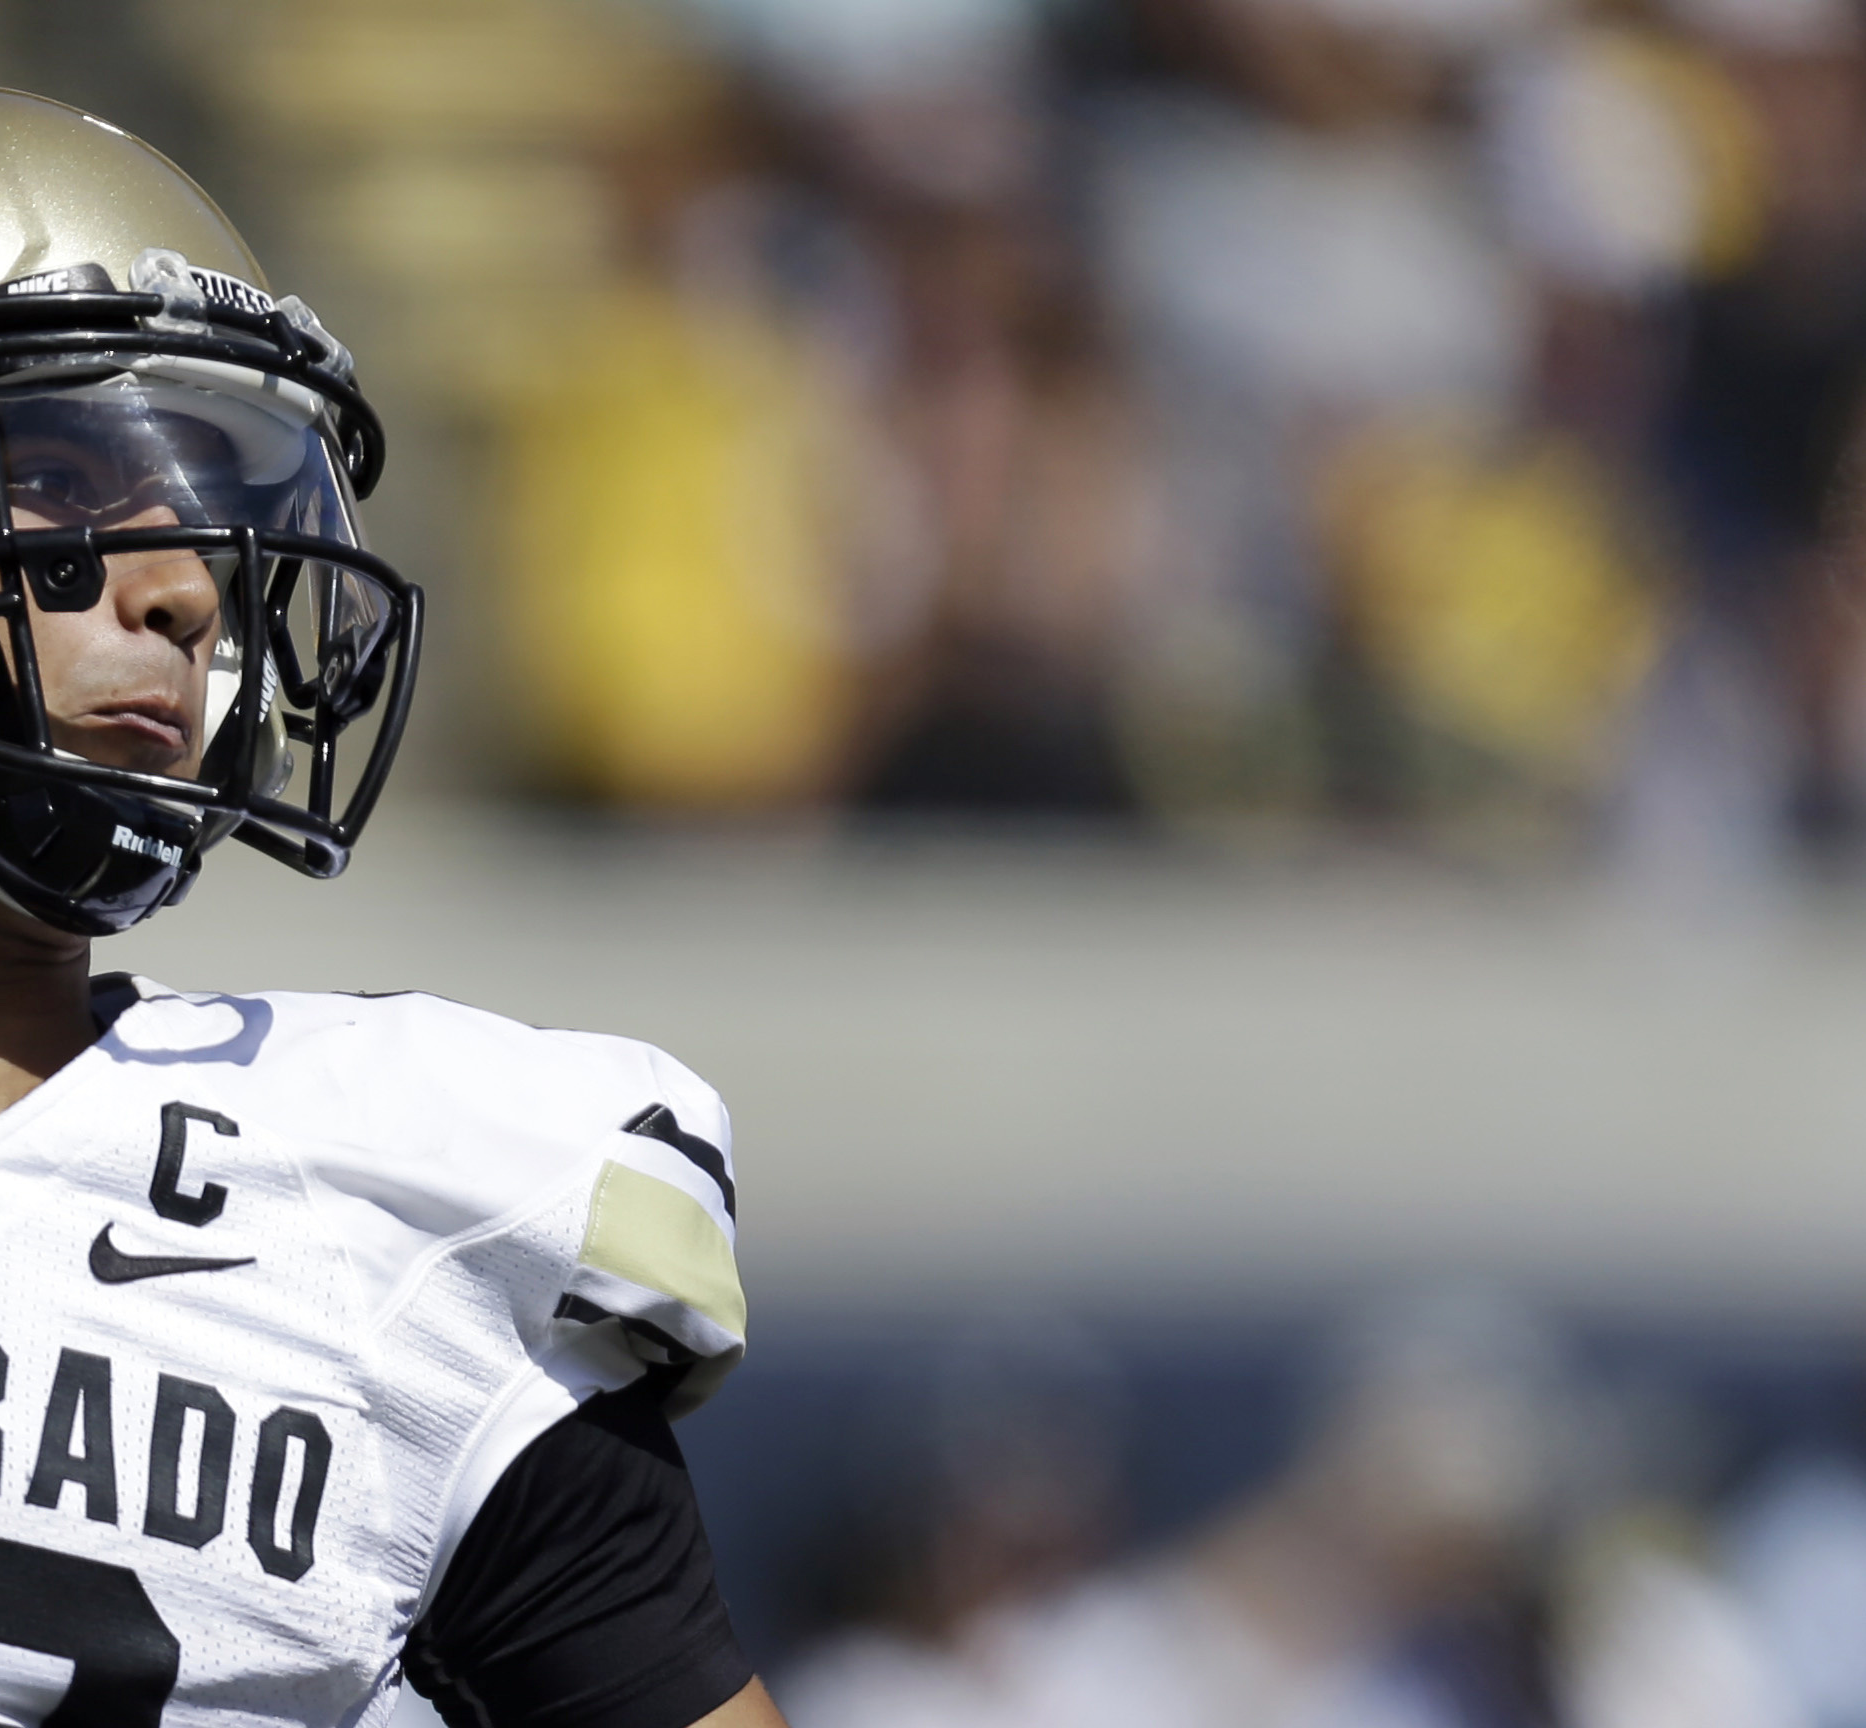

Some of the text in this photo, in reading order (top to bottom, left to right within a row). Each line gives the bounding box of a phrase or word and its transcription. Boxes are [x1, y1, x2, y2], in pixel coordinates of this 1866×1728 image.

[7, 270, 69, 295] NIKE
[112, 824, 183, 868] Riddell
[148, 1101, 240, 1227] C
